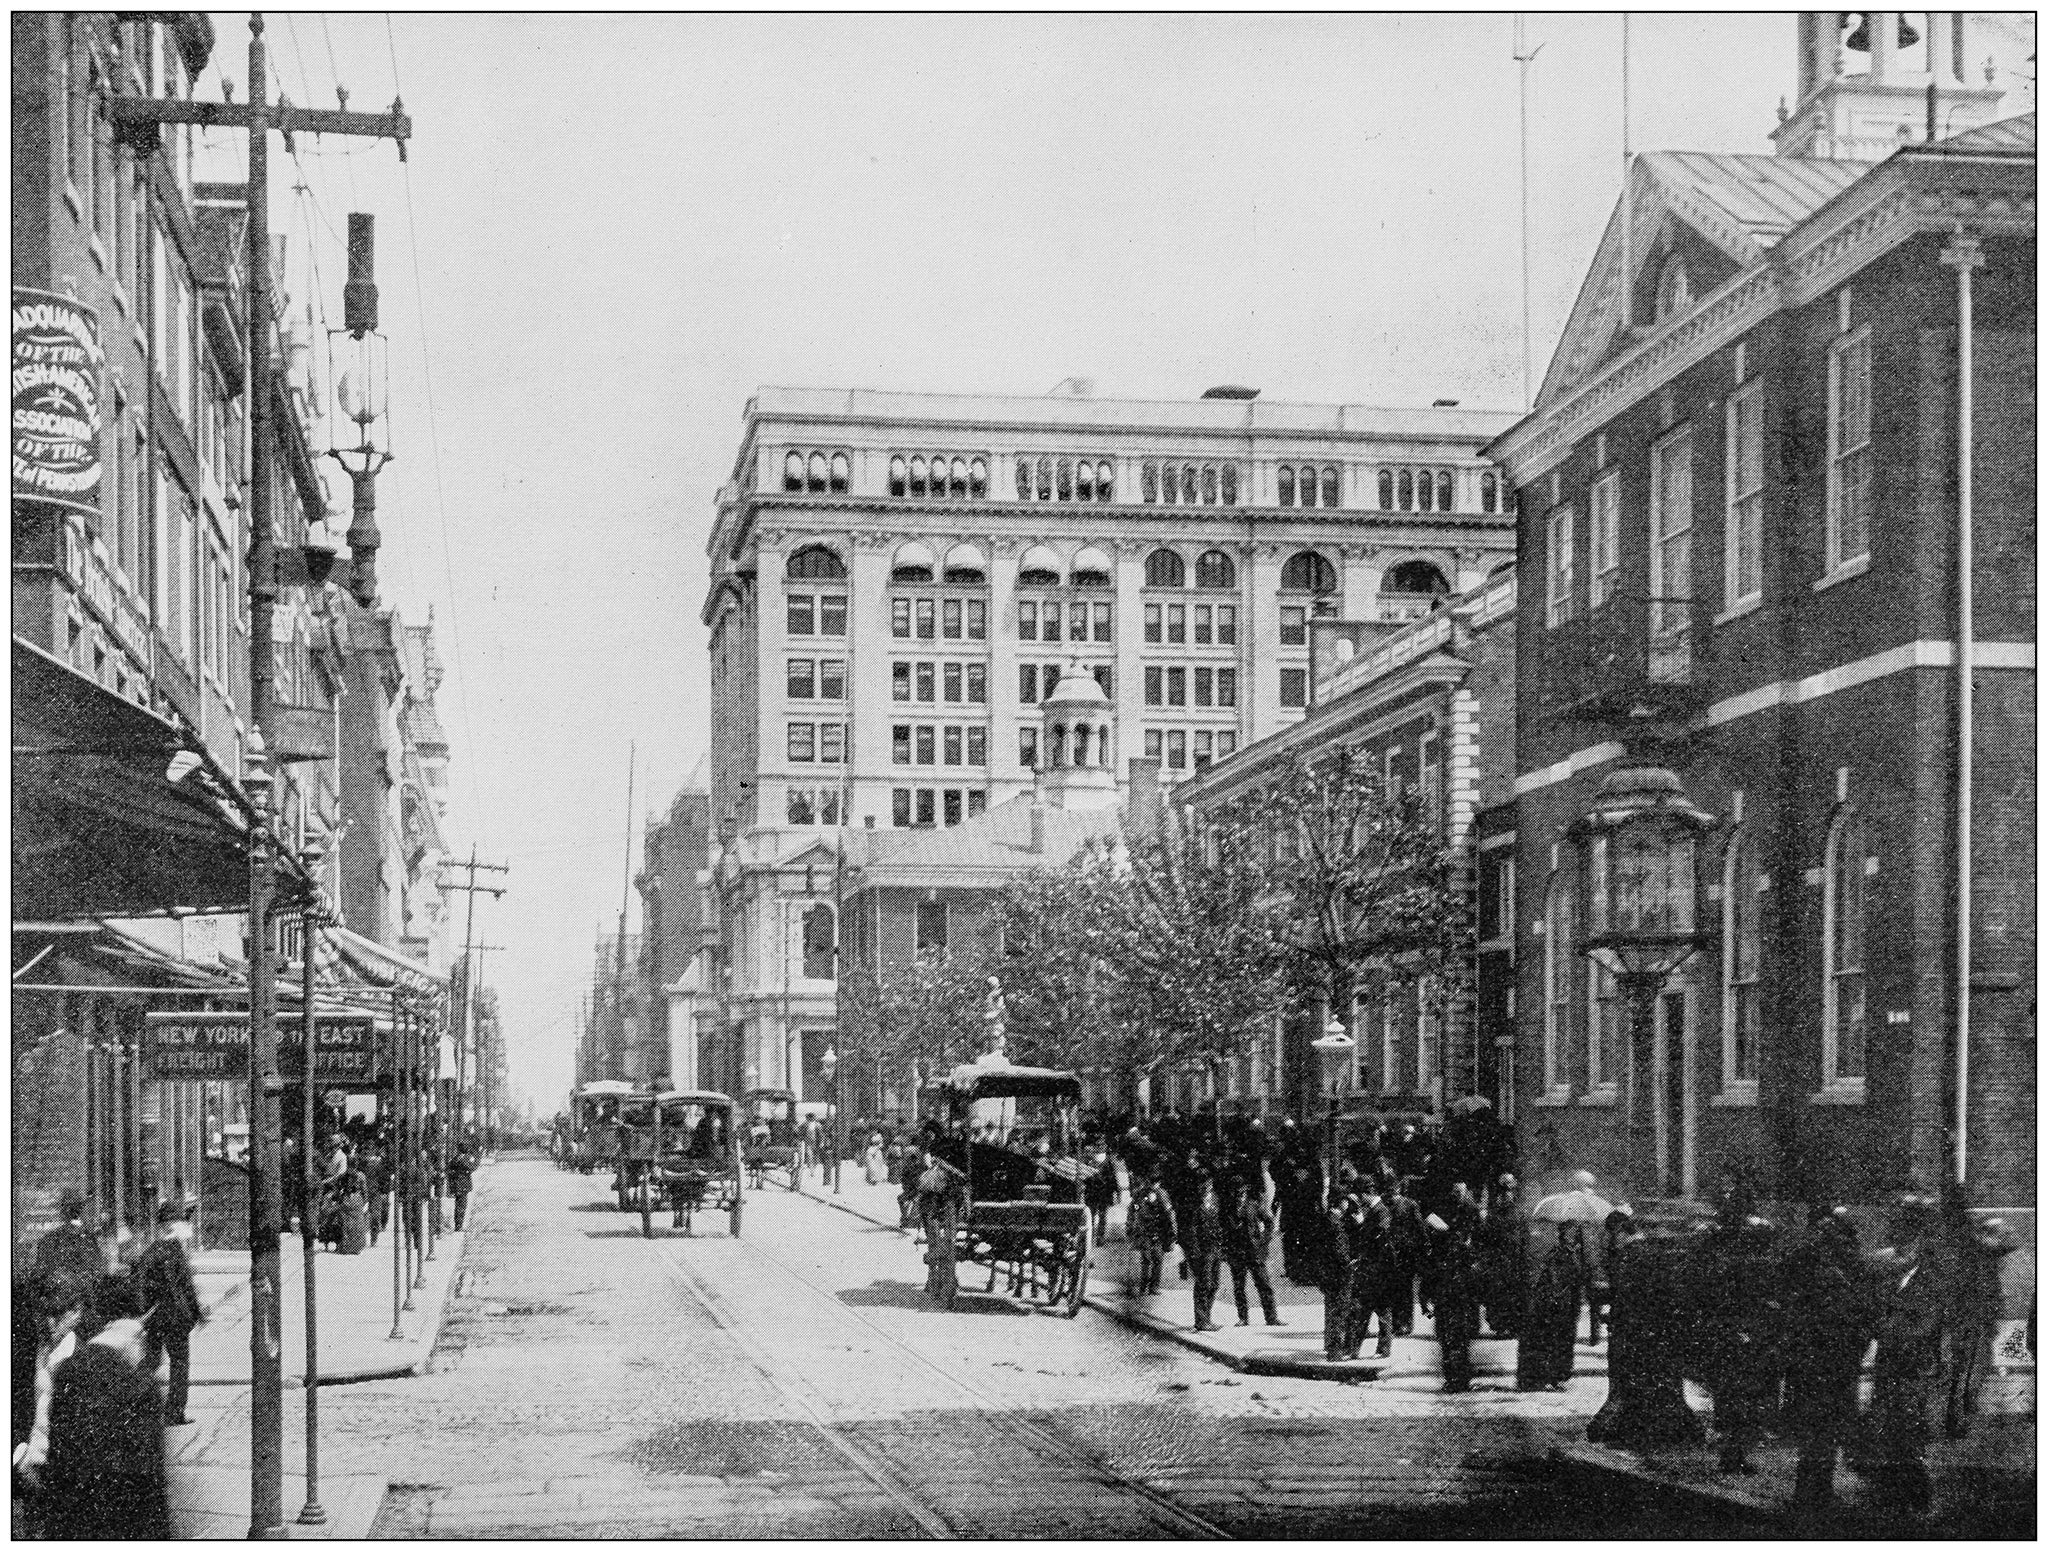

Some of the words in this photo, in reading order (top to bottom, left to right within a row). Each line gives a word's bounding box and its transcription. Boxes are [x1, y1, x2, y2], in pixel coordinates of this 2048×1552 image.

[157, 1026, 198, 1044] NEW
[205, 1025, 251, 1044] YORK
[320, 1026, 365, 1044] EAST
[314, 1052, 366, 1069] FFICE
